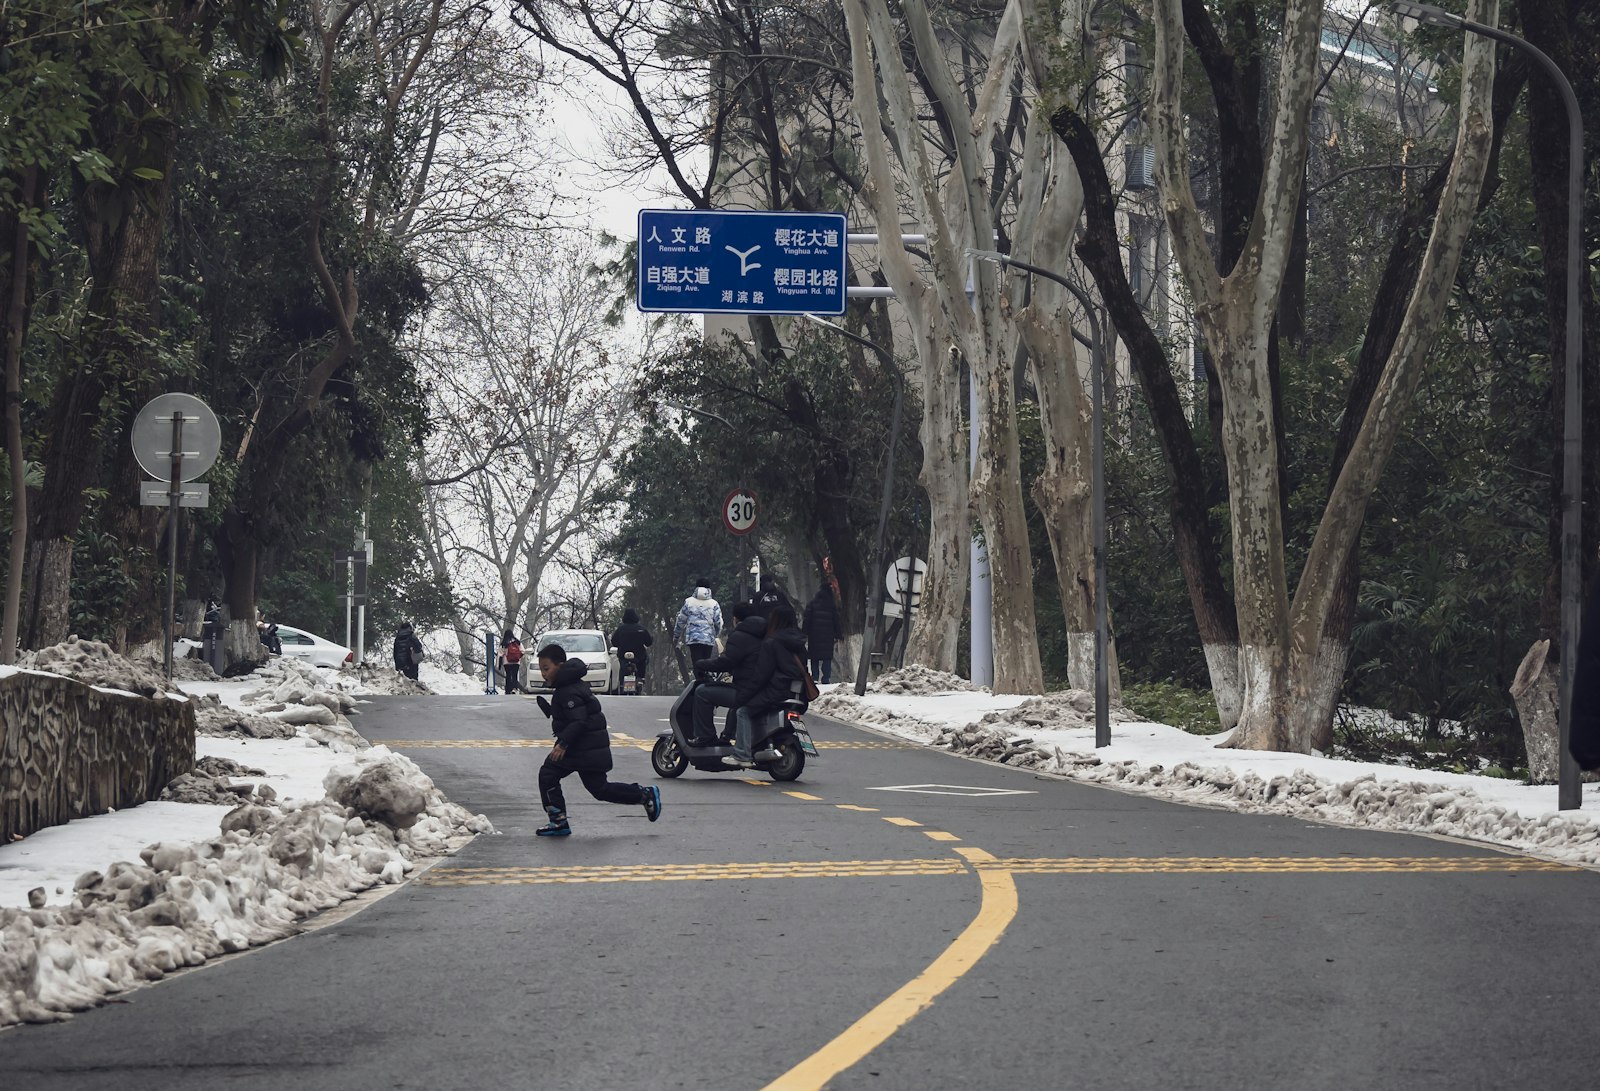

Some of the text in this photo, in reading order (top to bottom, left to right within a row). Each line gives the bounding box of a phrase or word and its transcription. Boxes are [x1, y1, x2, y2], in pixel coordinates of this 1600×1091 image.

[647, 226, 711, 244] 人文路
[774, 228, 838, 247] 樱花大道
[783, 247, 811, 255] Yinghua
[647, 266, 710, 284] 自强大道
[773, 268, 838, 287] 樱园北路
[656, 284, 682, 292] Ziqiang
[721, 290, 764, 304] 湖滨路
[777, 287, 808, 295] Yingyuan
[811, 287, 822, 295] Rd.
[731, 502, 753, 521] 30
